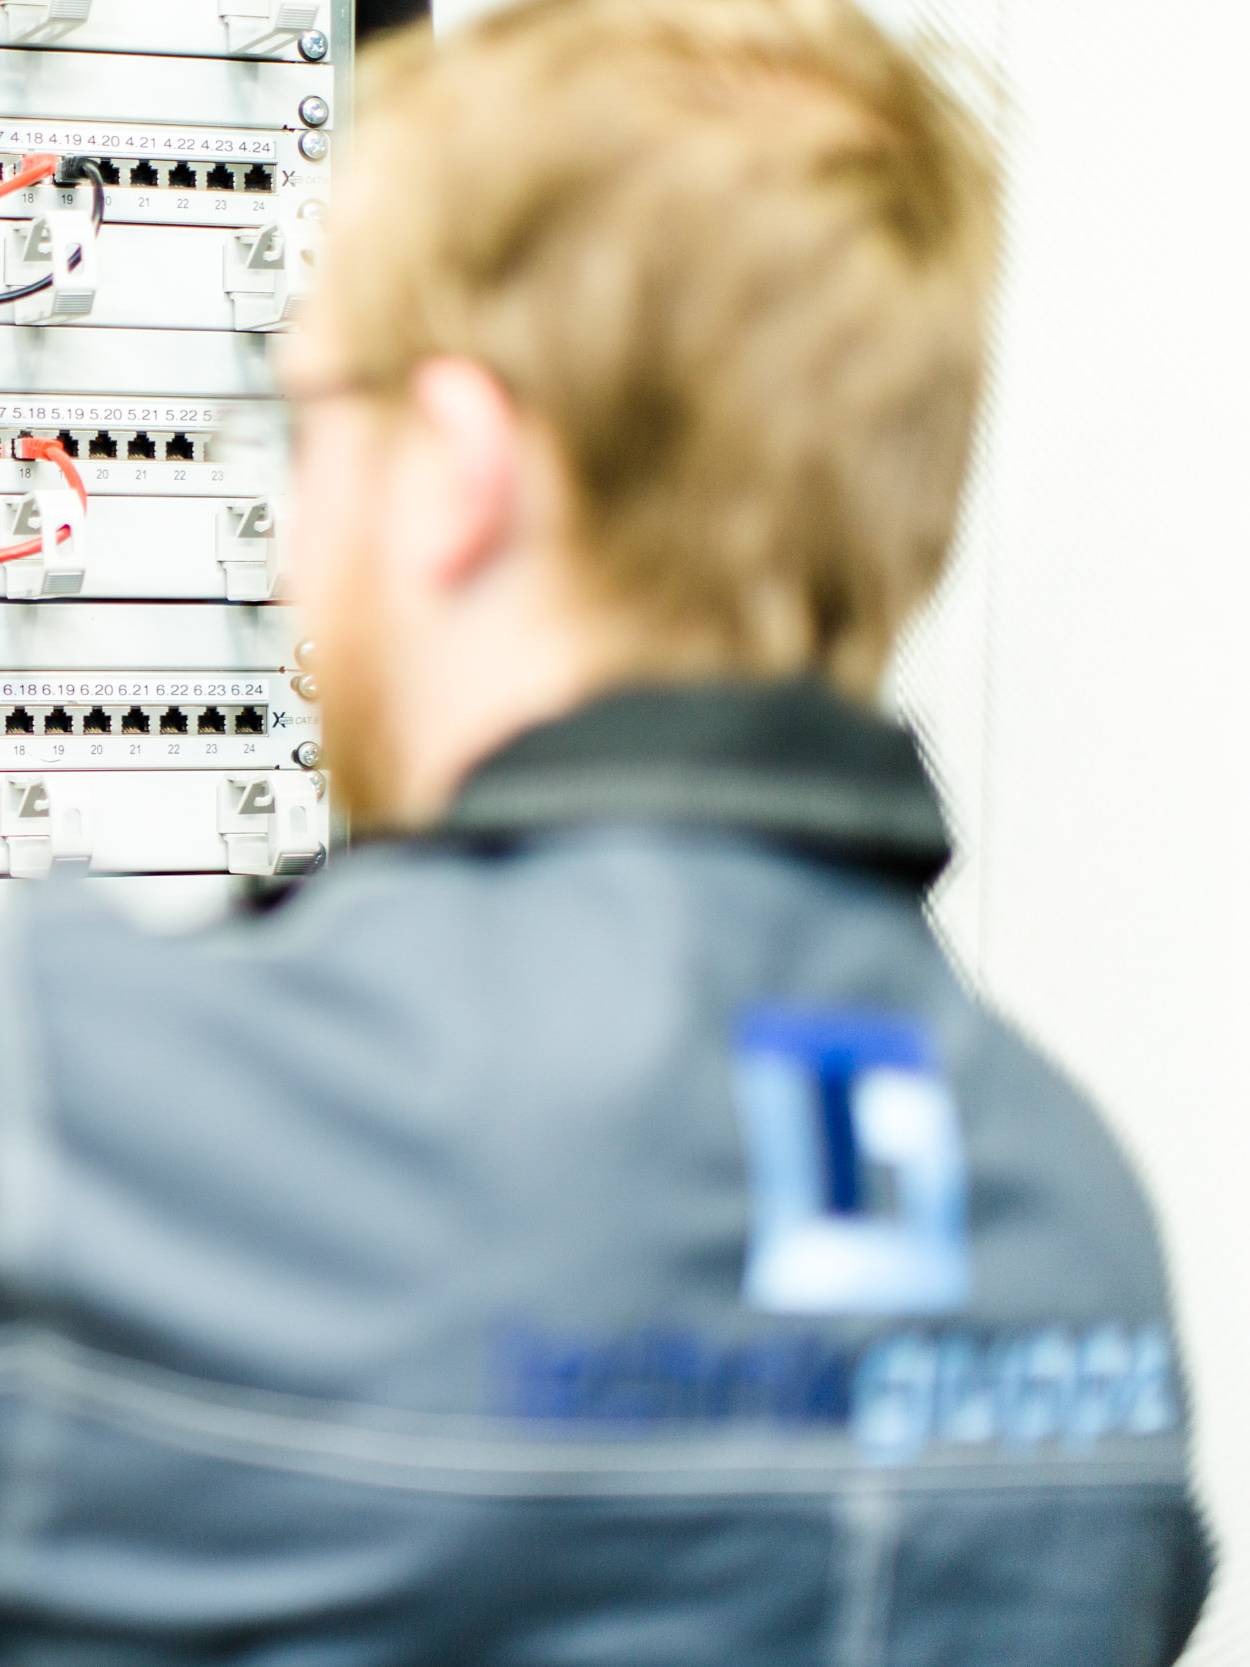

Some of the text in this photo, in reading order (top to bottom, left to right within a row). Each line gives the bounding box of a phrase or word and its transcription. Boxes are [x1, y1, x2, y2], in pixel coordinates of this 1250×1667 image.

[10, 132, 43, 144] 4.18
[49, 134, 82, 145] 4.19
[88, 135, 119, 147] 4.20
[126, 137, 155, 148] 4.21
[164, 138, 195, 150] 4.22
[201, 140, 233, 152] 4.23
[239, 142, 270, 153] 4.24
[23, 191, 265, 211] 18 19 21 22 23 24
[13, 408, 45, 419] 5.18
[51, 408, 84, 419] 5.19
[90, 409, 122, 420] 5.20
[128, 409, 157, 420] 5.21
[166, 410, 197, 421] 5.22
[20, 469, 30, 477] 18
[97, 469, 108, 479] 20
[135, 470, 146, 480] 21
[174, 470, 185, 480] 22
[212, 471, 223, 481] 23
[3, 684, 37, 695] 6.18
[42, 684, 75, 695] 6.19
[80, 684, 113, 695] 6.20
[118, 685, 148, 696] 6.21
[156, 685, 188, 696] 6.22
[194, 685, 226, 696] 6.23
[231, 684, 263, 695] 6.24
[14, 745, 25, 755] 18
[54, 745, 64, 755] 19
[91, 745, 102, 755] 20
[130, 744, 140, 754] 21
[168, 744, 180, 754] 22
[206, 744, 217, 754] 23
[244, 744, 255, 753] 24
